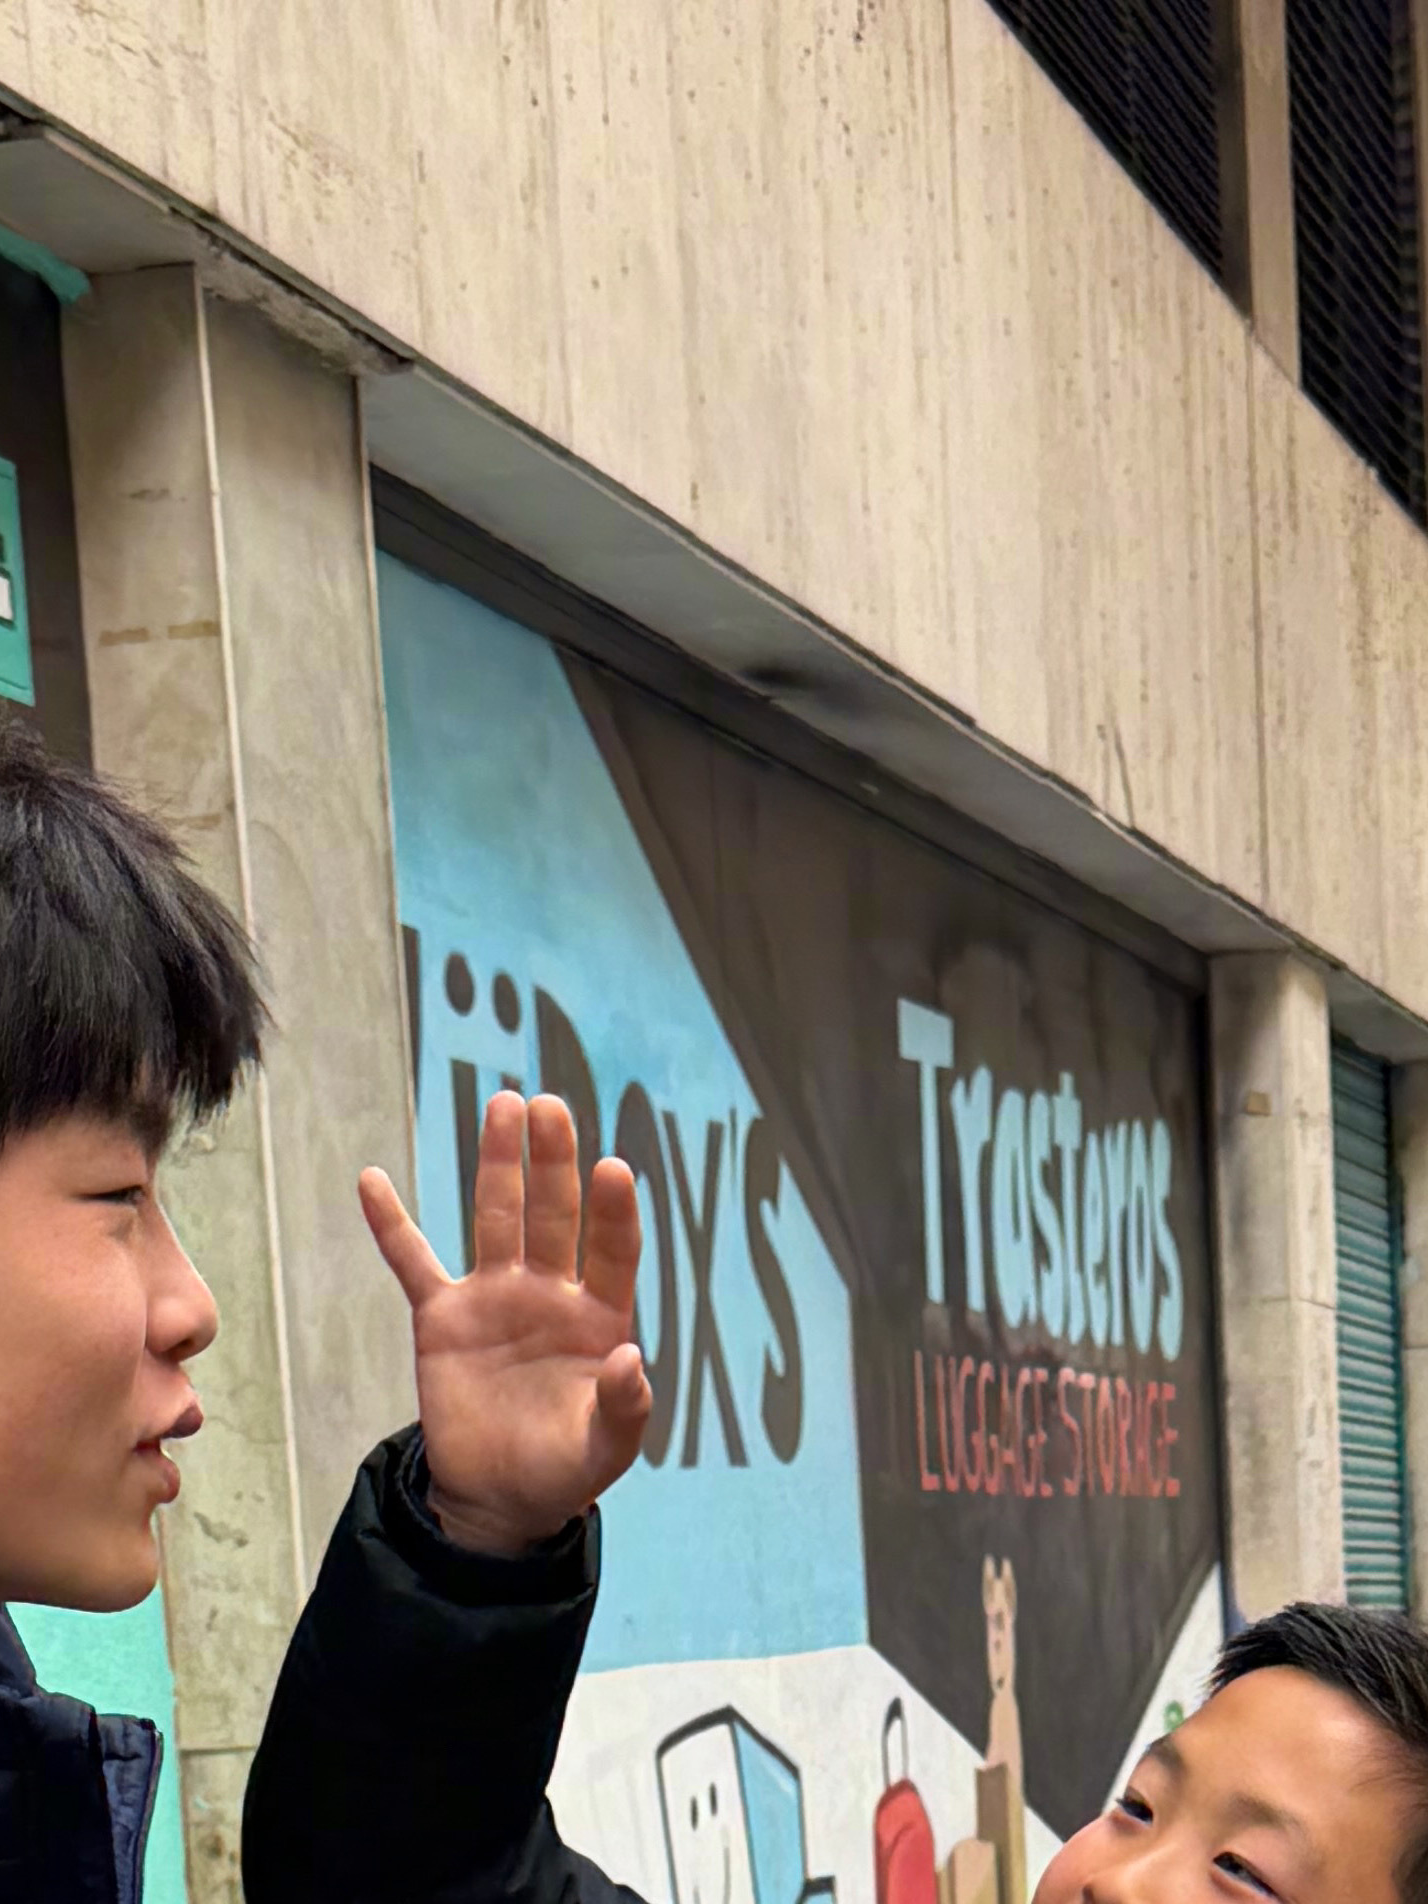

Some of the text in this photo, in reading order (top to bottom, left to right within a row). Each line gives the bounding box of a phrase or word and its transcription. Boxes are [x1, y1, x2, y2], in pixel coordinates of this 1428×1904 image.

[897, 997, 1184, 1362] Trasteros
[914, 1350, 1181, 1498] LUGGAGE STORAGE
